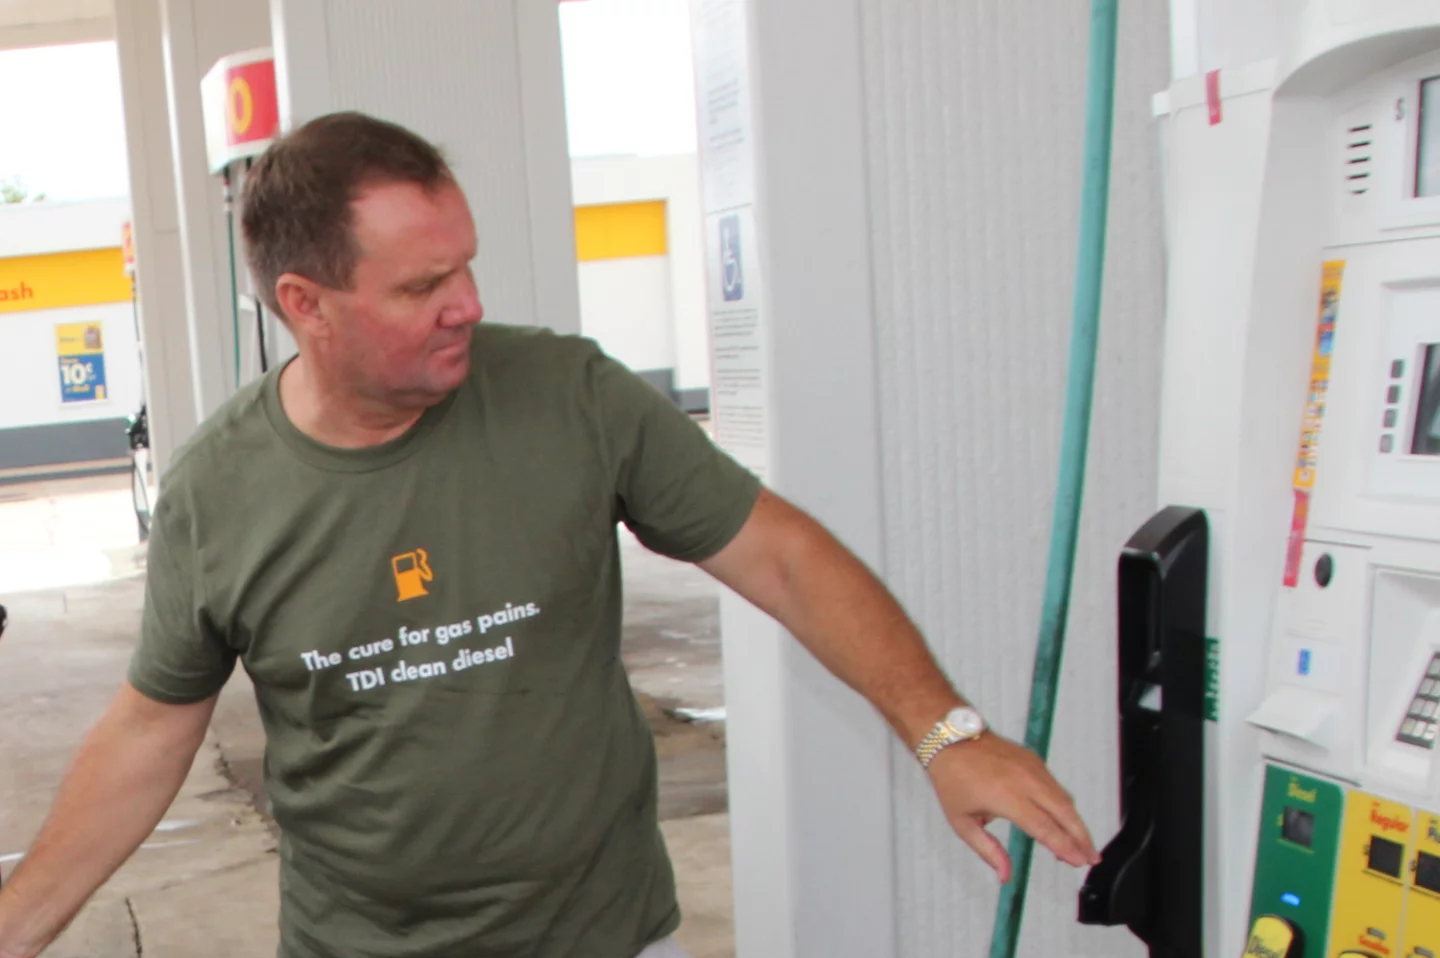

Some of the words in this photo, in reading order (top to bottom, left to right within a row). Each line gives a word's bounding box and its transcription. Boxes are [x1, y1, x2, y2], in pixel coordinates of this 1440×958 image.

[301, 649, 342, 671] The
[348, 637, 394, 660] cure
[399, 626, 430, 646] for
[435, 619, 472, 645] gas
[477, 602, 541, 633] pains.
[345, 667, 386, 692] TDI
[391, 660, 447, 683] clean
[452, 637, 515, 671] diesel
